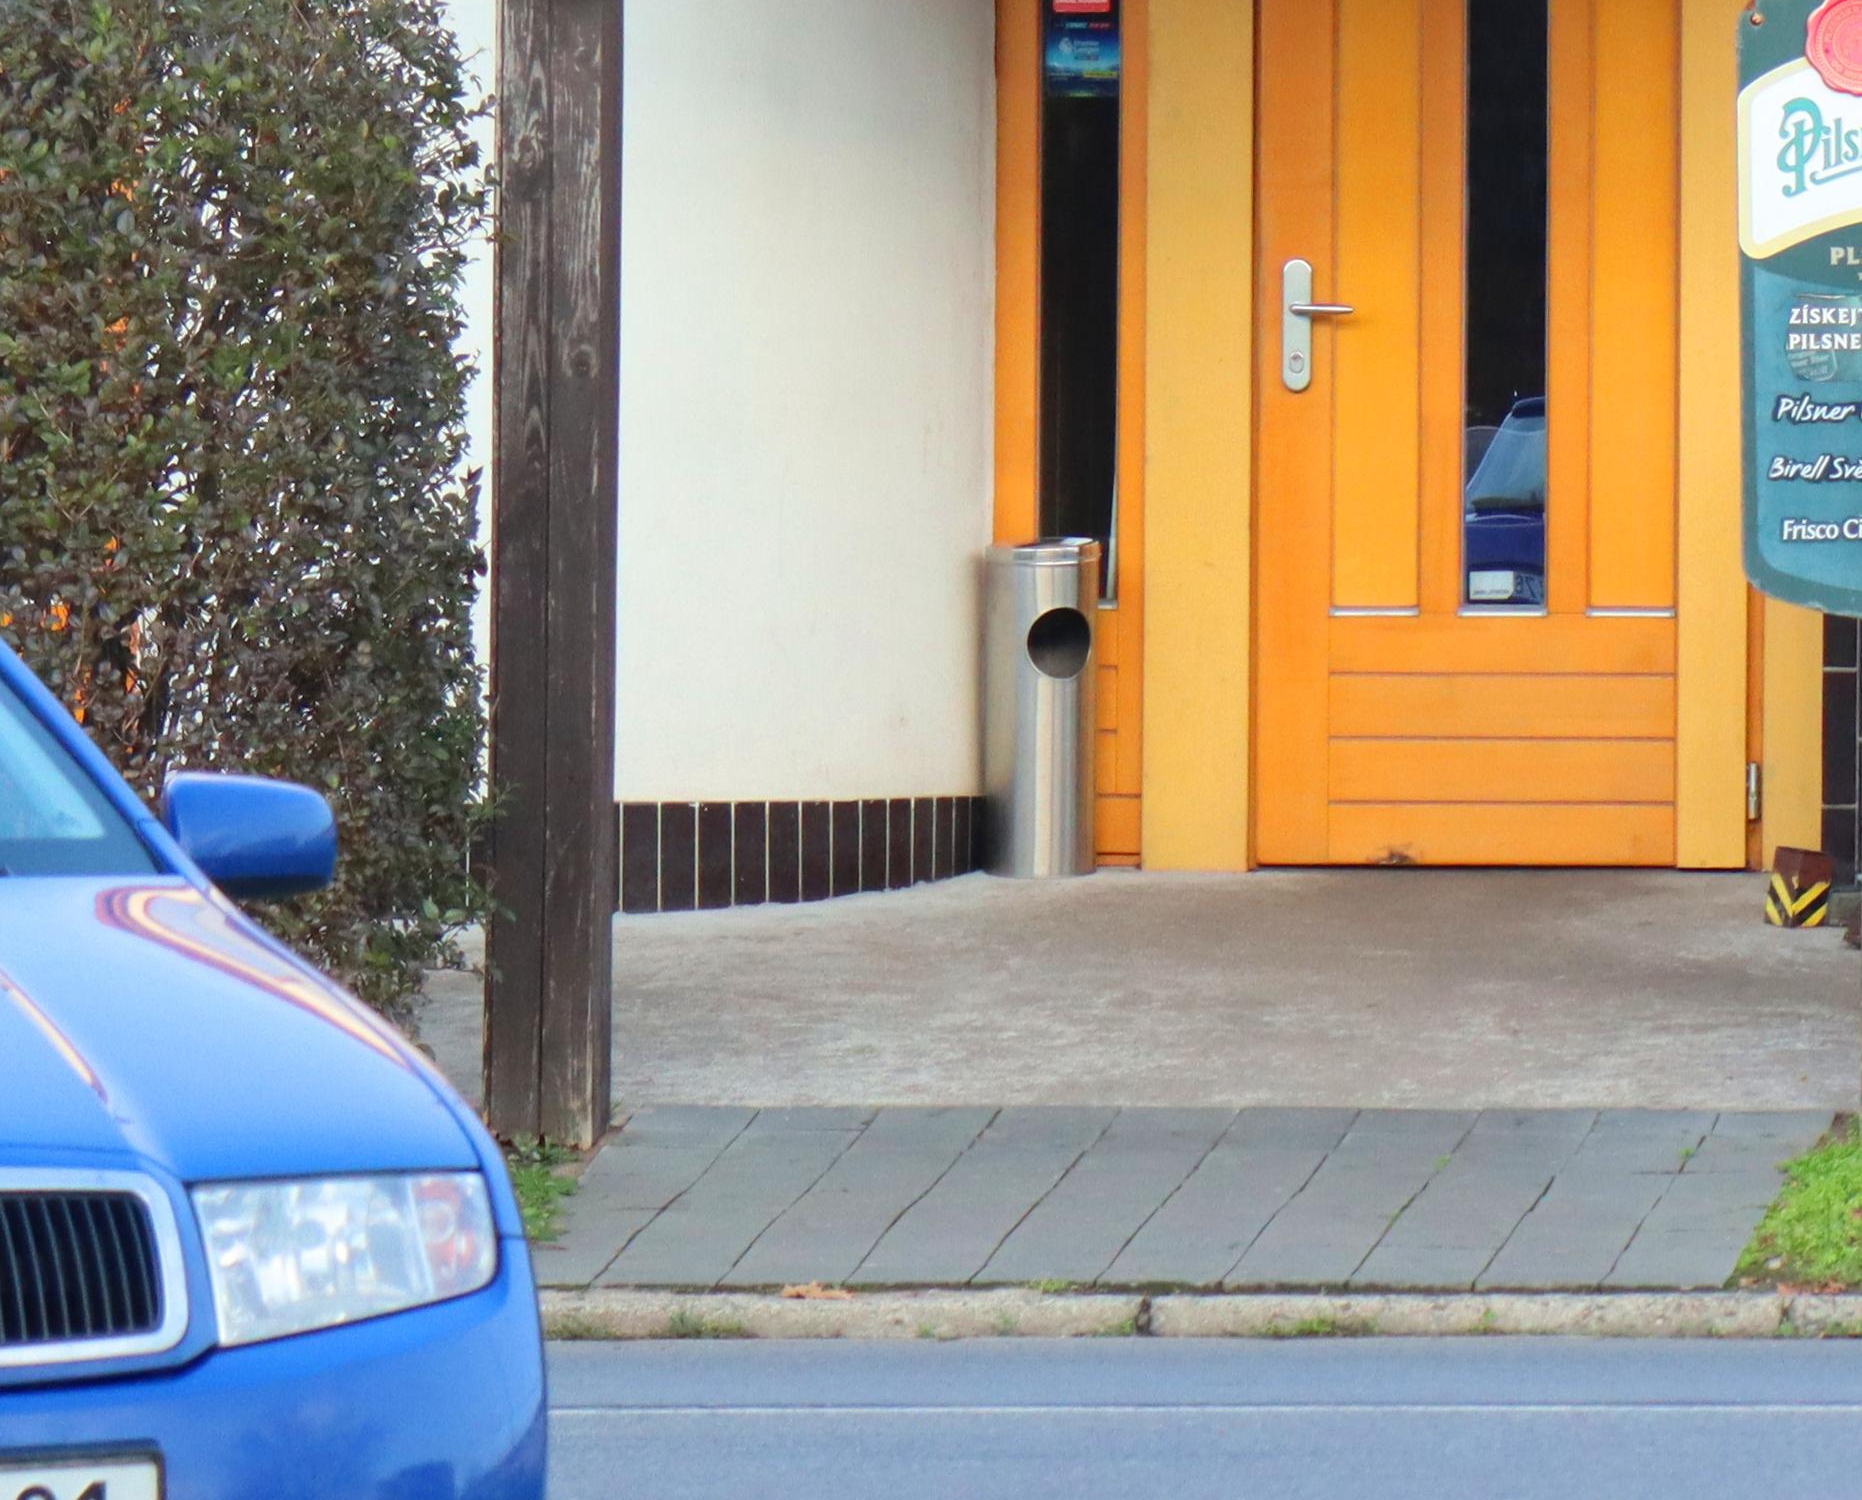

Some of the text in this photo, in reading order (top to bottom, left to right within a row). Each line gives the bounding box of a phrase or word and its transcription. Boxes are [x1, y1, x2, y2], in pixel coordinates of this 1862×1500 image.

[1777, 395, 1855, 421] Pilsner
[1769, 455, 1831, 479] Birell
[1783, 518, 1839, 540] Frisco
